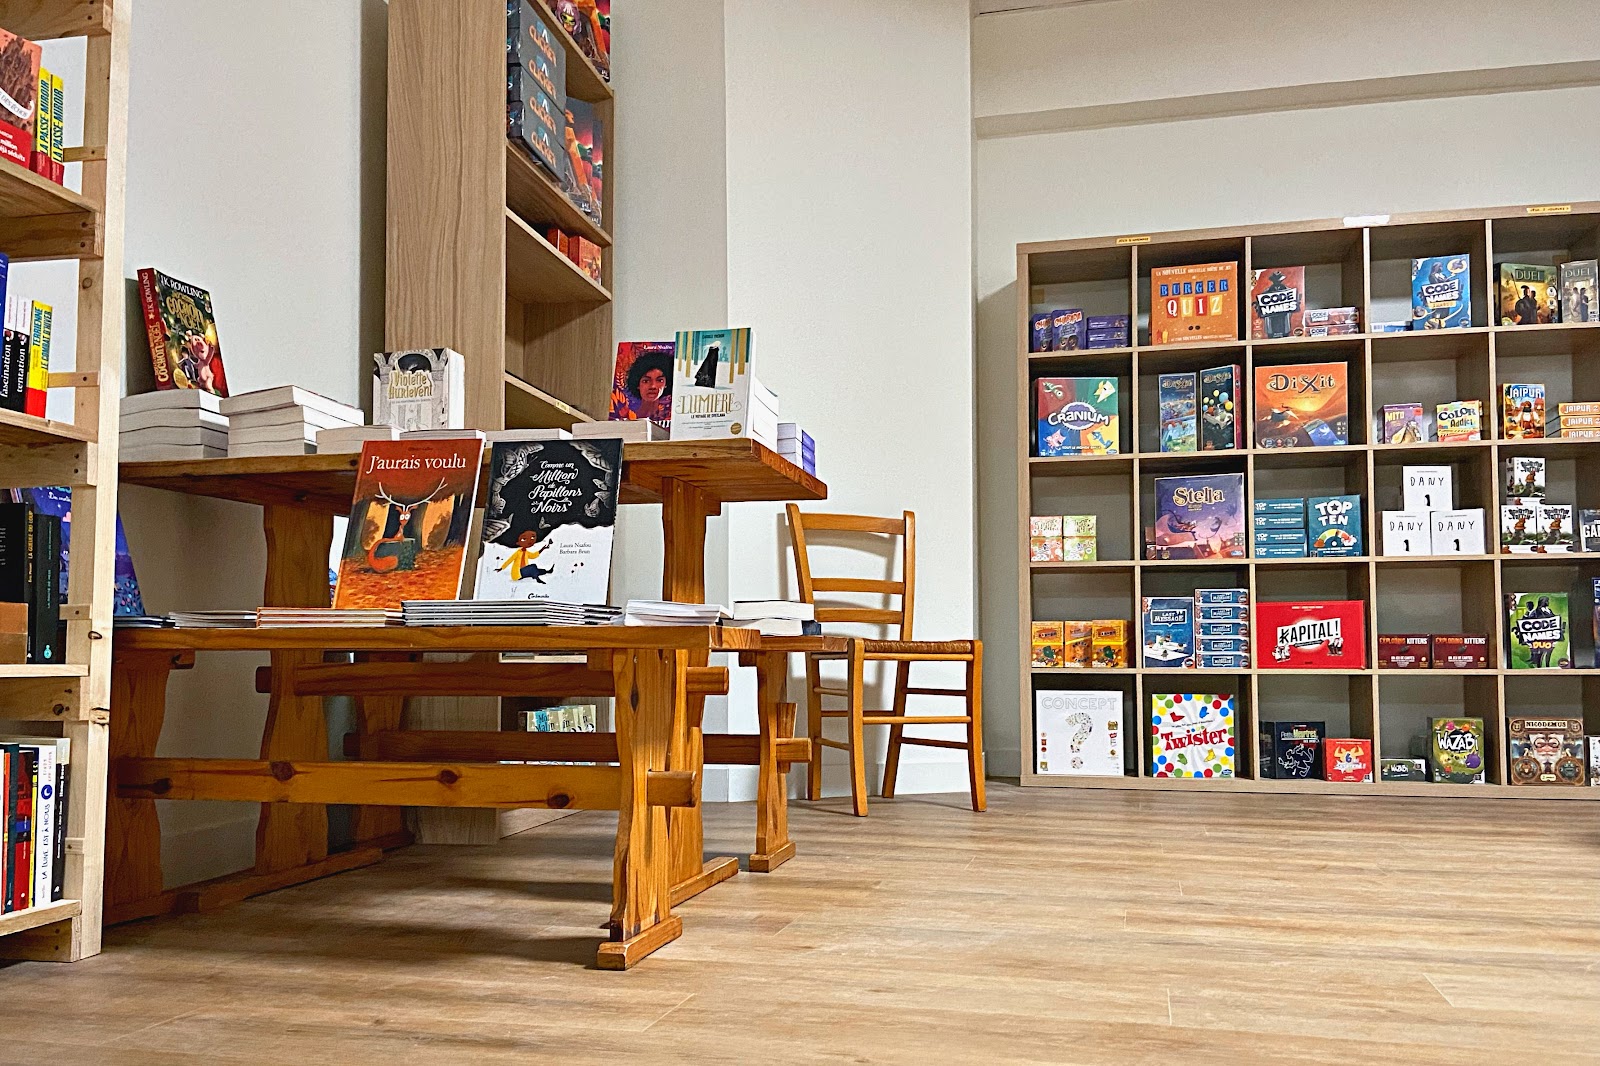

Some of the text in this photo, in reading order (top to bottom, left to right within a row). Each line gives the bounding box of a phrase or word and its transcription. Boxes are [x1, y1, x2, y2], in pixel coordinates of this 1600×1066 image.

[40, 79, 49, 143] PASSE-MIROIR
[53, 88, 63, 151] PASSE-MIROIR
[39, 143, 48, 155] LA
[53, 151, 62, 163] LA
[1516, 270, 1542, 280] DUEL
[1565, 267, 1591, 278] DUEL
[170, 279, 204, 300] ROWLING
[1160, 279, 1228, 297] BURGER
[1425, 281, 1457, 295] CODE
[1260, 291, 1295, 305] CODE
[1426, 291, 1460, 303] NAMES
[1166, 295, 1222, 317] QUIZ
[1260, 301, 1298, 315] NAMES
[32, 306, 43, 346] TERRIENNE
[42, 336, 50, 362] COMBAT
[0, 344, 11, 397] fascination
[16, 348, 26, 393] tentation
[395, 371, 427, 387] Violette
[1508, 387, 1542, 398] JAIPUR
[676, 391, 740, 414] LUMIÈRE
[1565, 405, 1591, 413] JAIPUR
[1567, 417, 1593, 426] JAIPUR
[1569, 430, 1594, 438] JAIPUR
[366, 453, 467, 474] J'aurais voulu
[540, 460, 565, 469] Comme
[529, 468, 579, 485] Million
[1410, 476, 1444, 487] DANY
[528, 484, 583, 501] Papillons
[1173, 486, 1226, 506] Stella
[530, 498, 572, 514] Noirs
[1314, 499, 1353, 516] TOP
[1318, 514, 1349, 526] TEN
[1389, 521, 1423, 531] DANY
[1438, 520, 1475, 532] DANY
[1521, 618, 1558, 631] CODE
[1279, 620, 1340, 645] KAPITAL!
[1523, 629, 1561, 642] NAMES
[1406, 637, 1428, 645] KITTENS
[1464, 637, 1486, 645] KITTENS
[1532, 641, 1552, 649] DUO
[1041, 696, 1118, 711] CONCEPT
[1160, 728, 1228, 752] Twister
[1345, 752, 1352, 763] 6
